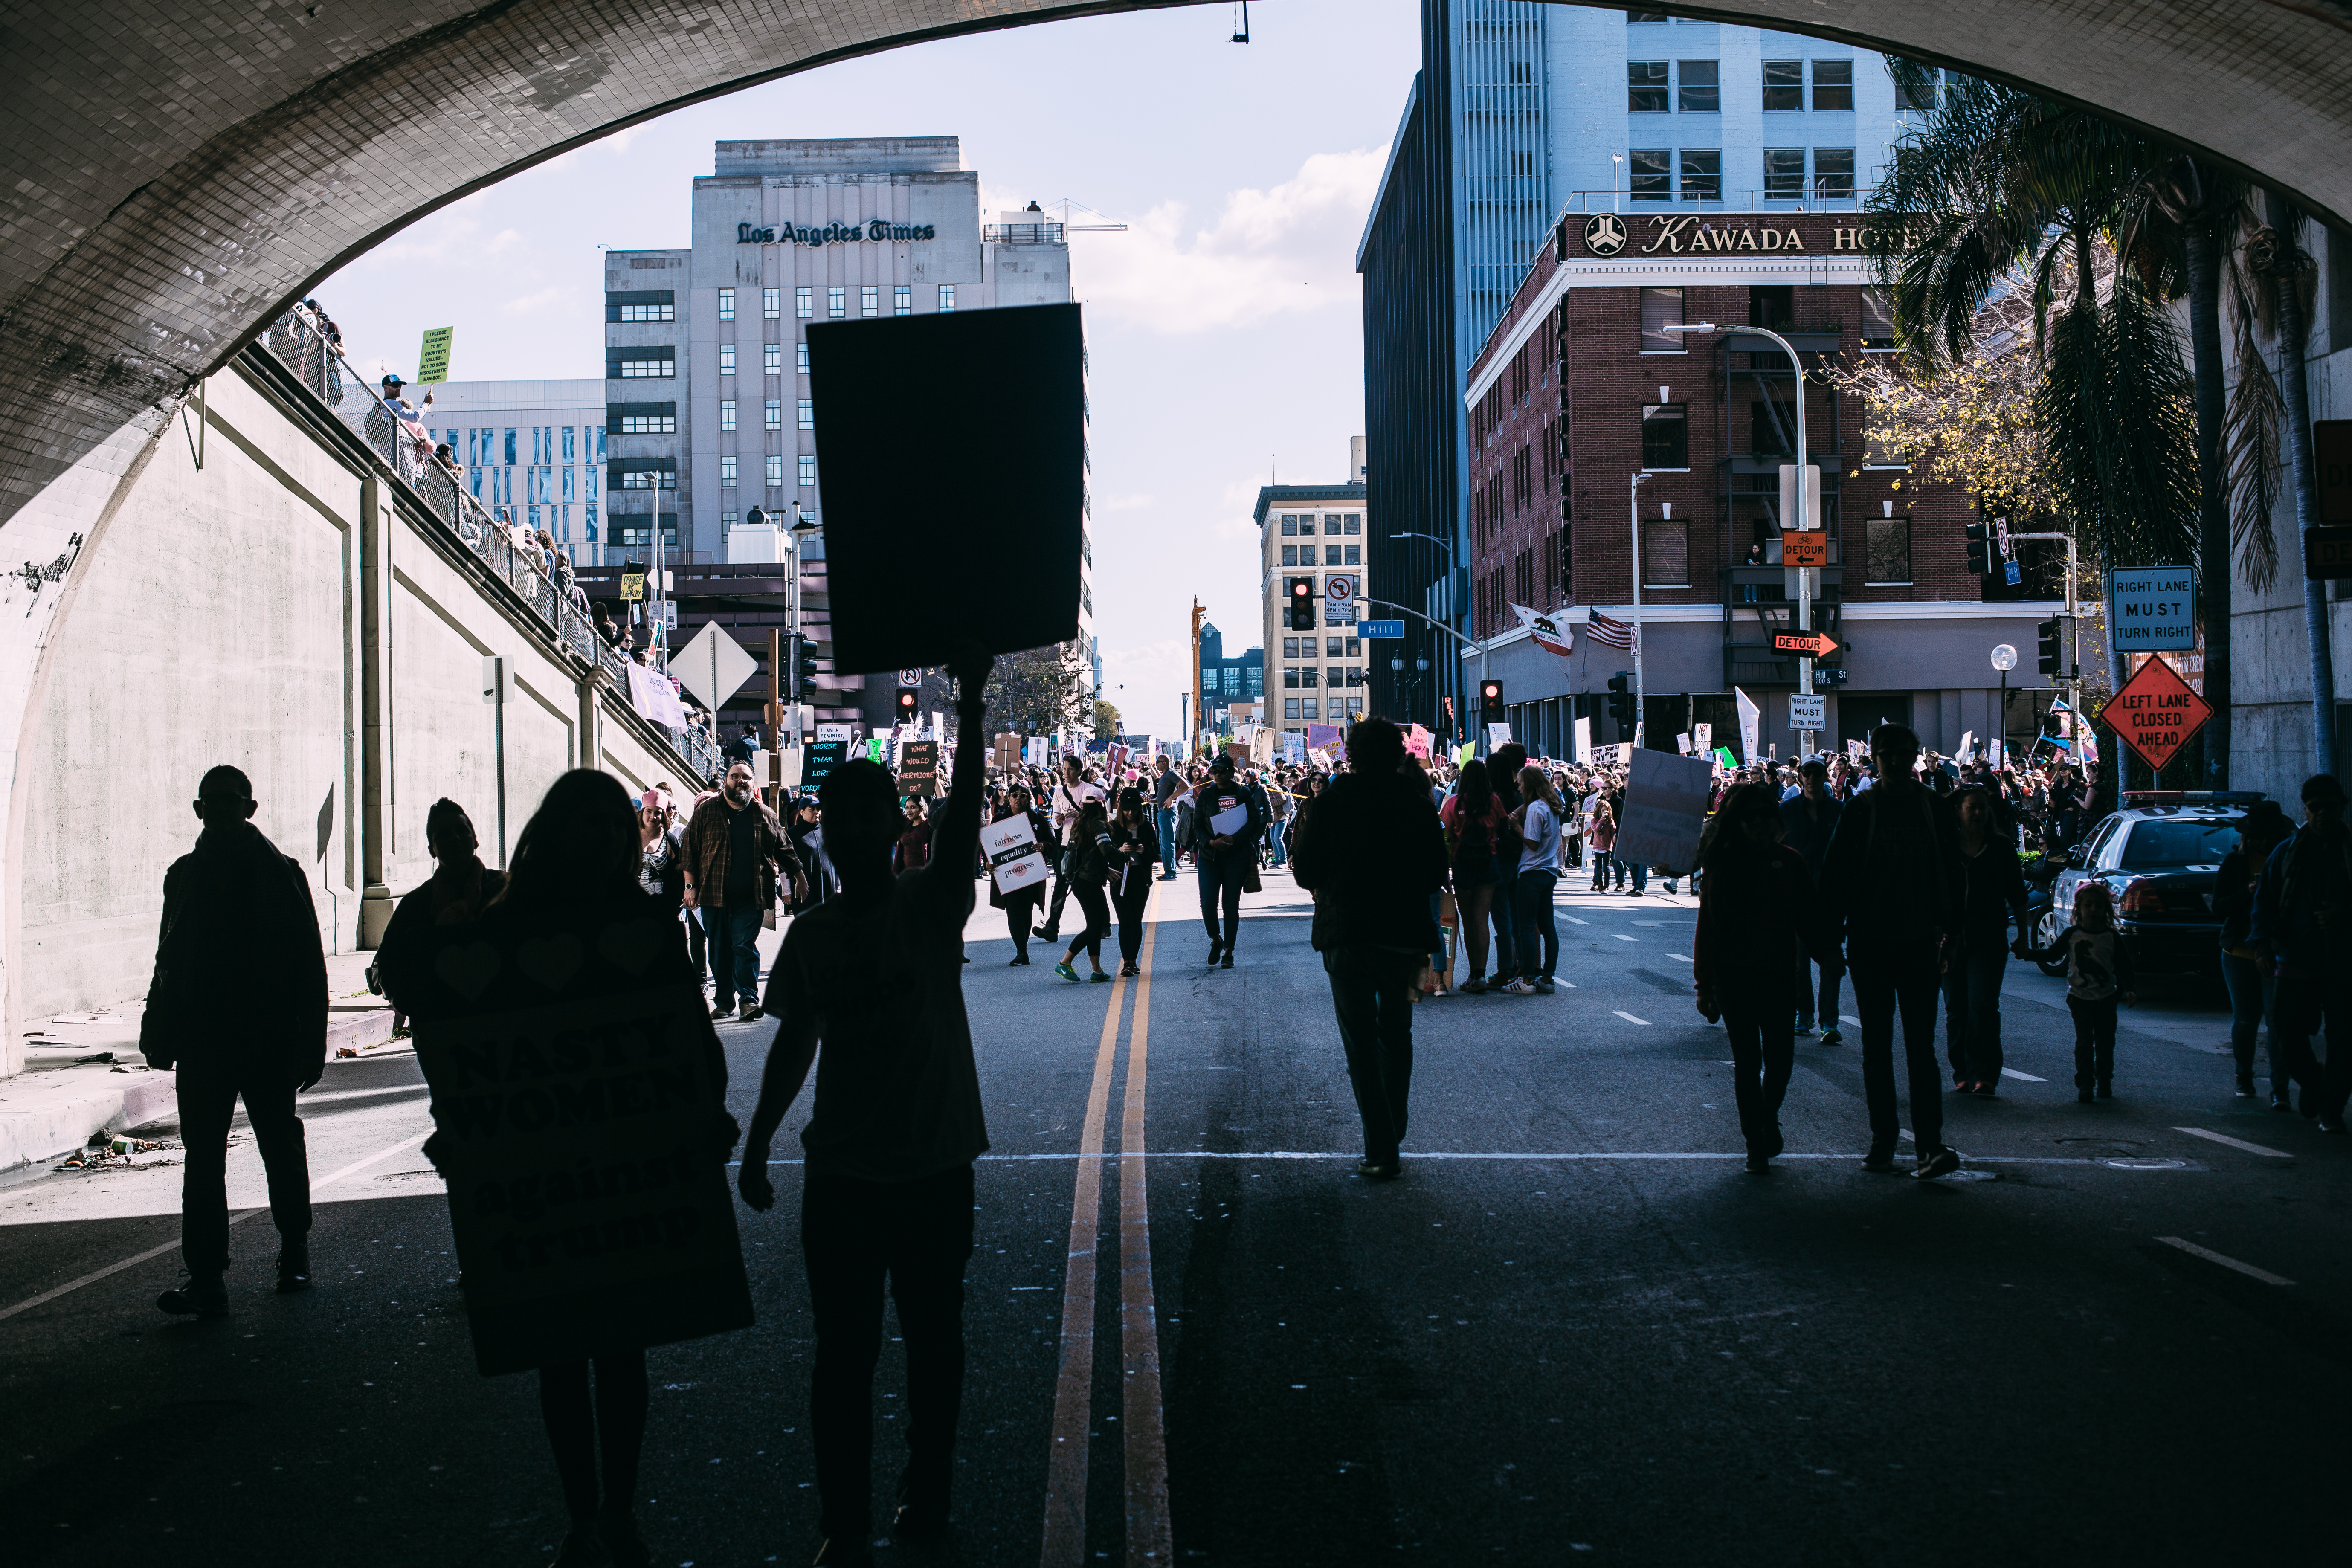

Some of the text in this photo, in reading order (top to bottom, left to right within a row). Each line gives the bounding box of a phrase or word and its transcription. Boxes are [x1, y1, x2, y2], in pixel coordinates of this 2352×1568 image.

[737, 219, 935, 247] Los Angeles Times
[1786, 545, 1824, 554] DETOUR
[2117, 581, 2189, 592] RIGHT LANE
[2126, 603, 2181, 617] MUST
[1369, 625, 1393, 634] Hill
[2117, 626, 2191, 638] TURN RIGHT
[1778, 637, 1821, 649] DETOUR
[2190, 655, 2204, 672] CREW
[2123, 694, 2191, 709] LEFT LANE
[2133, 713, 2182, 727] CLOSED
[1699, 725, 1708, 733] NOT
[2137, 731, 2179, 746] AHEAD
[911, 745, 929, 753] WHAT
[906, 757, 929, 765] WOULD
[900, 771, 934, 779] HERMIONE
[909, 784, 922, 792] DO?
[994, 833, 1023, 847] fairness
[1001, 847, 1027, 861] equality
[1004, 861, 1035, 878] progress
[448, 1012, 678, 1090] NASTY
[441, 1063, 697, 1141] WOMEN
[475, 1144, 699, 1222] against
[494, 1205, 702, 1272] trump
